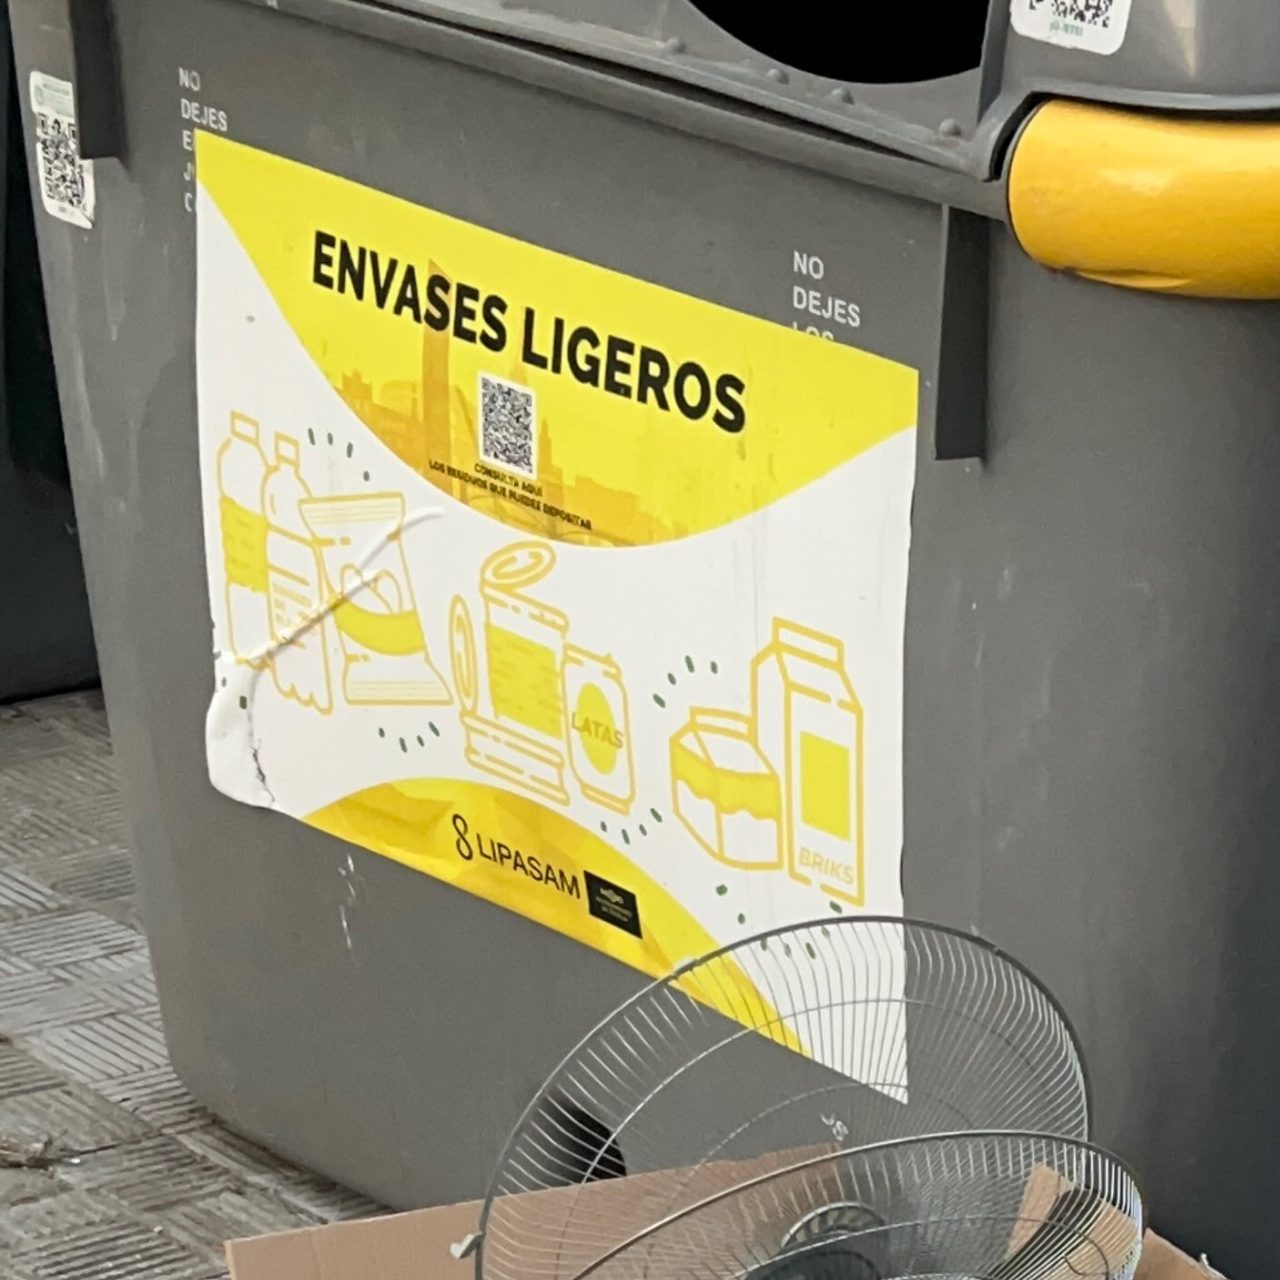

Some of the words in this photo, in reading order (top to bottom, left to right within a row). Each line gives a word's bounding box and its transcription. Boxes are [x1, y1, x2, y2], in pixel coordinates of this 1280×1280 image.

[178, 66, 201, 92] NO
[180, 97, 228, 132] DEJES
[793, 250, 824, 280] NO
[792, 285, 861, 328] DEJES
[312, 229, 508, 352] ENVASES
[521, 306, 746, 433] LIGEROS
[474, 462, 519, 487] CONSULTA
[571, 711, 624, 749] LATAS
[476, 832, 581, 900] LIPASAM
[799, 846, 854, 885] BRIKS
